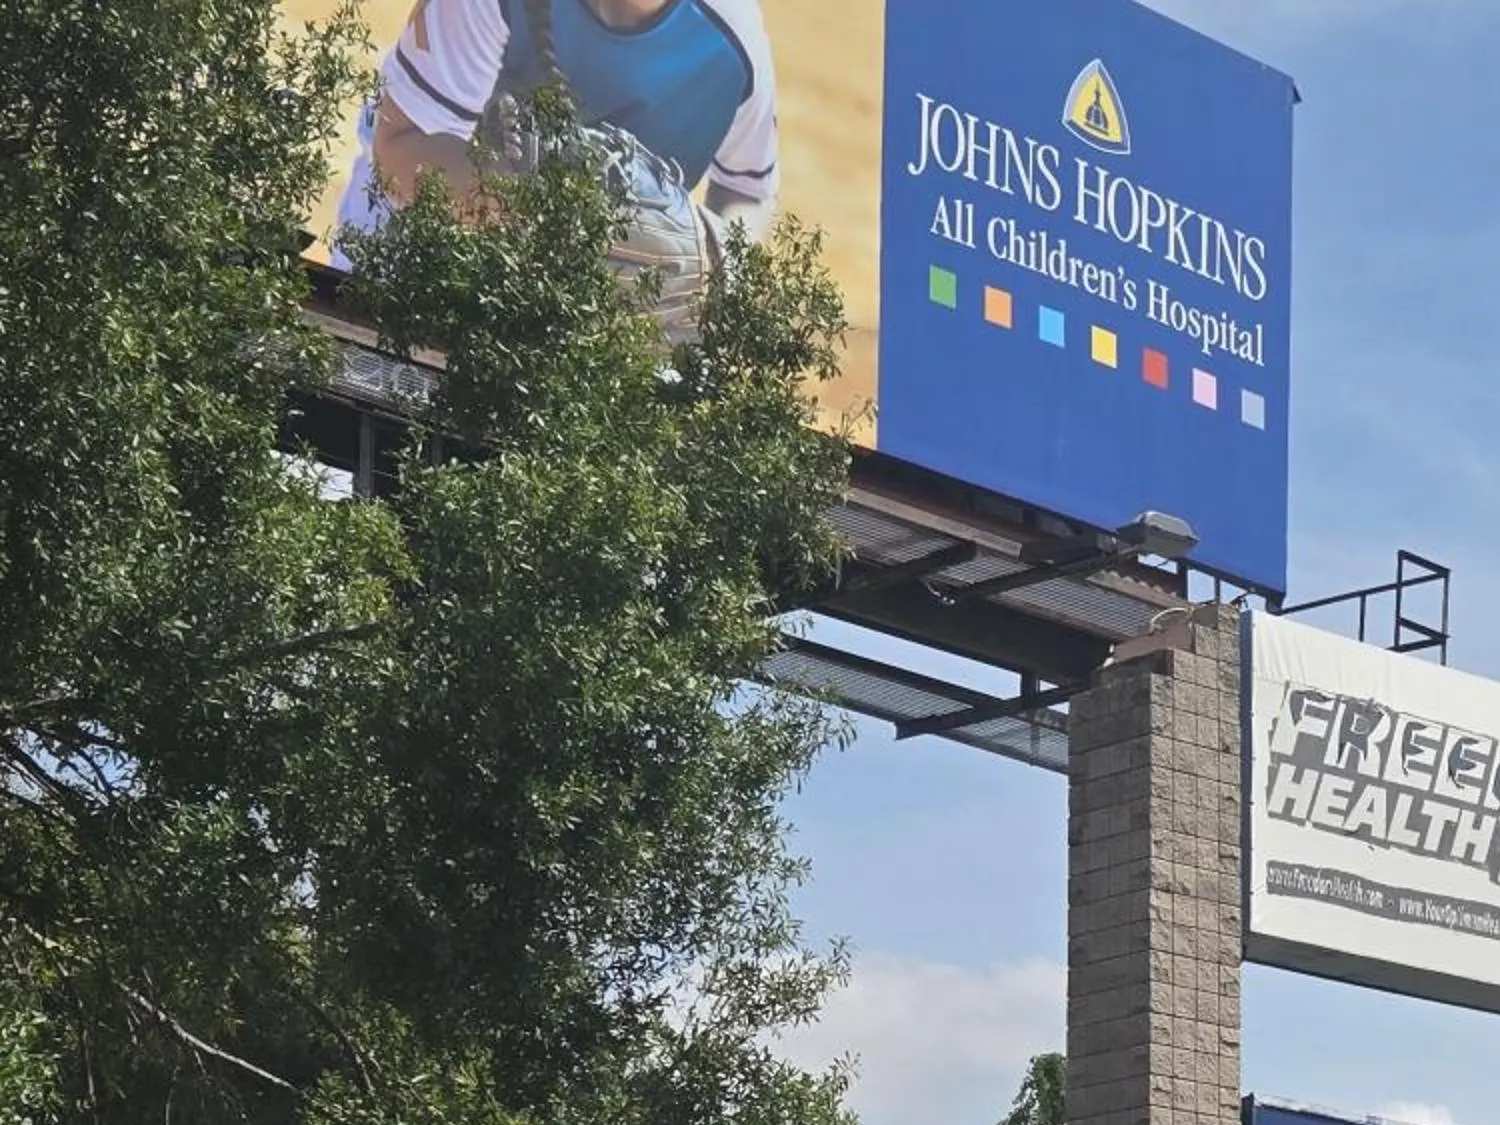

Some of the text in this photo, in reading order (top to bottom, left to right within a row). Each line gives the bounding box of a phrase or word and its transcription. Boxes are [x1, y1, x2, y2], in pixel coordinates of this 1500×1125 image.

[908, 92, 1268, 301] JOHNS HOPKINS
[930, 196, 1265, 367] All Children's Hospital
[1268, 762, 1498, 864] HEALTH
